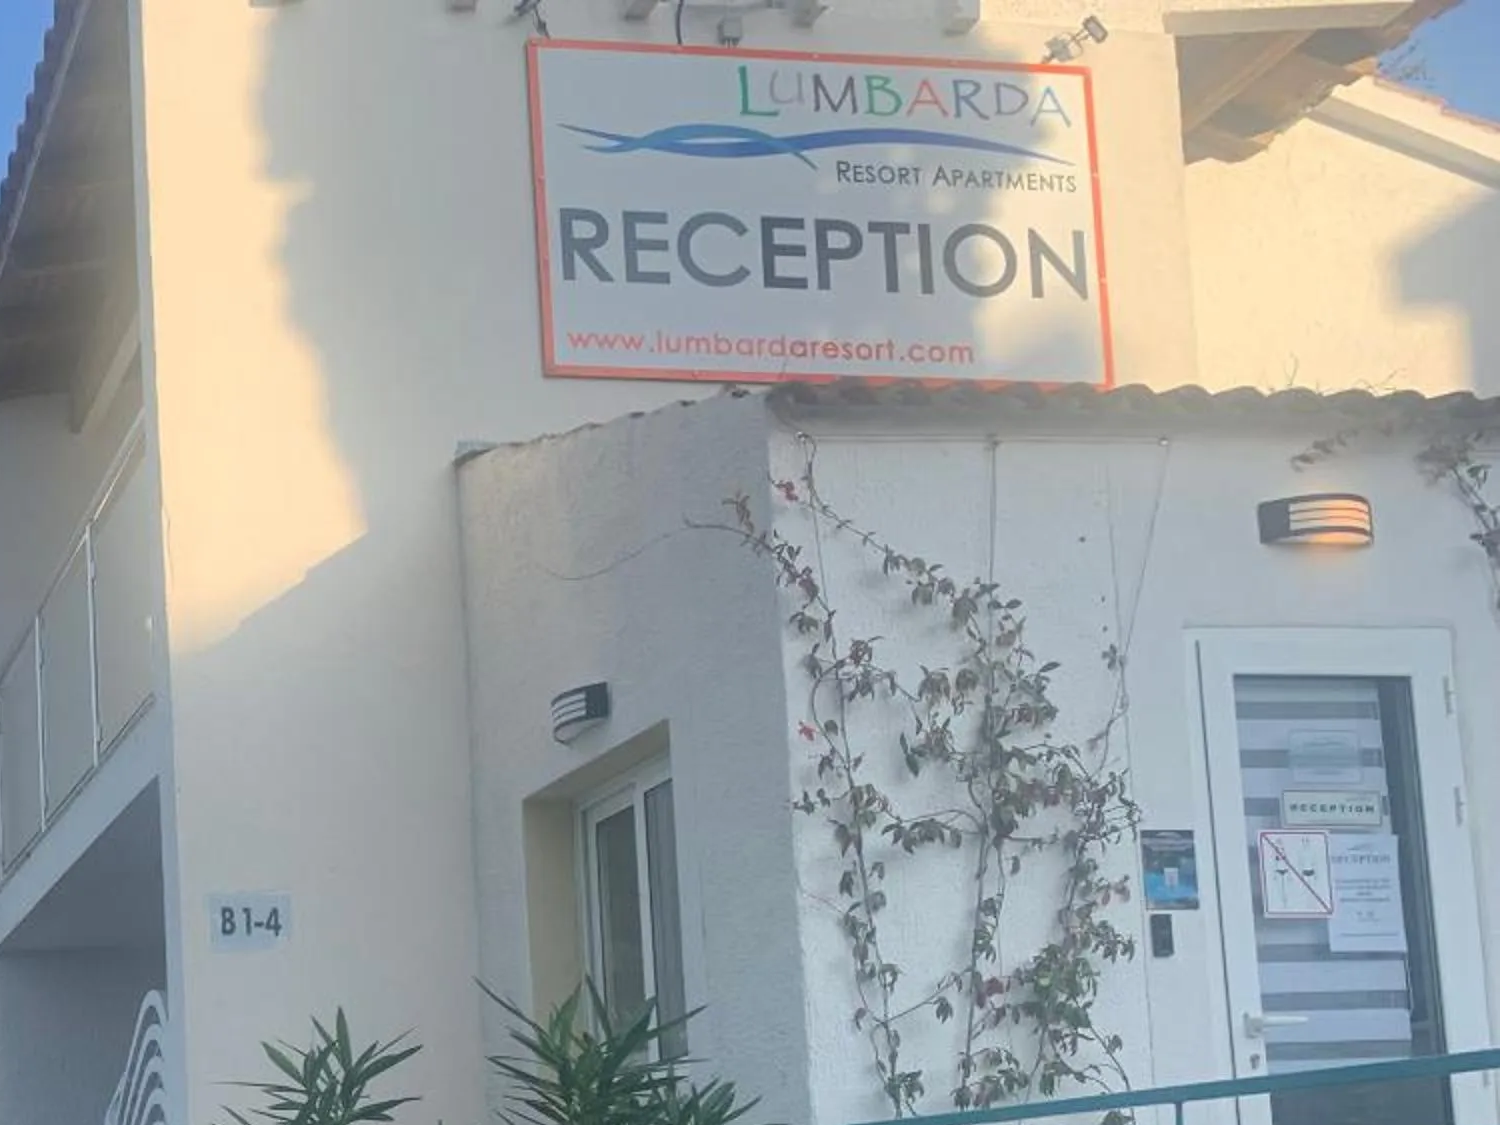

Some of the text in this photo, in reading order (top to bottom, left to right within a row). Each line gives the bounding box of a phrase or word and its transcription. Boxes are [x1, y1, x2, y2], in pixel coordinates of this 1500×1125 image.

[738, 66, 1071, 127] LUMBARDA
[836, 161, 1077, 193] RESORT APARTMENTS
[559, 207, 1088, 299] RECEPTION
[568, 330, 974, 364] www.lumbardaresort.com
